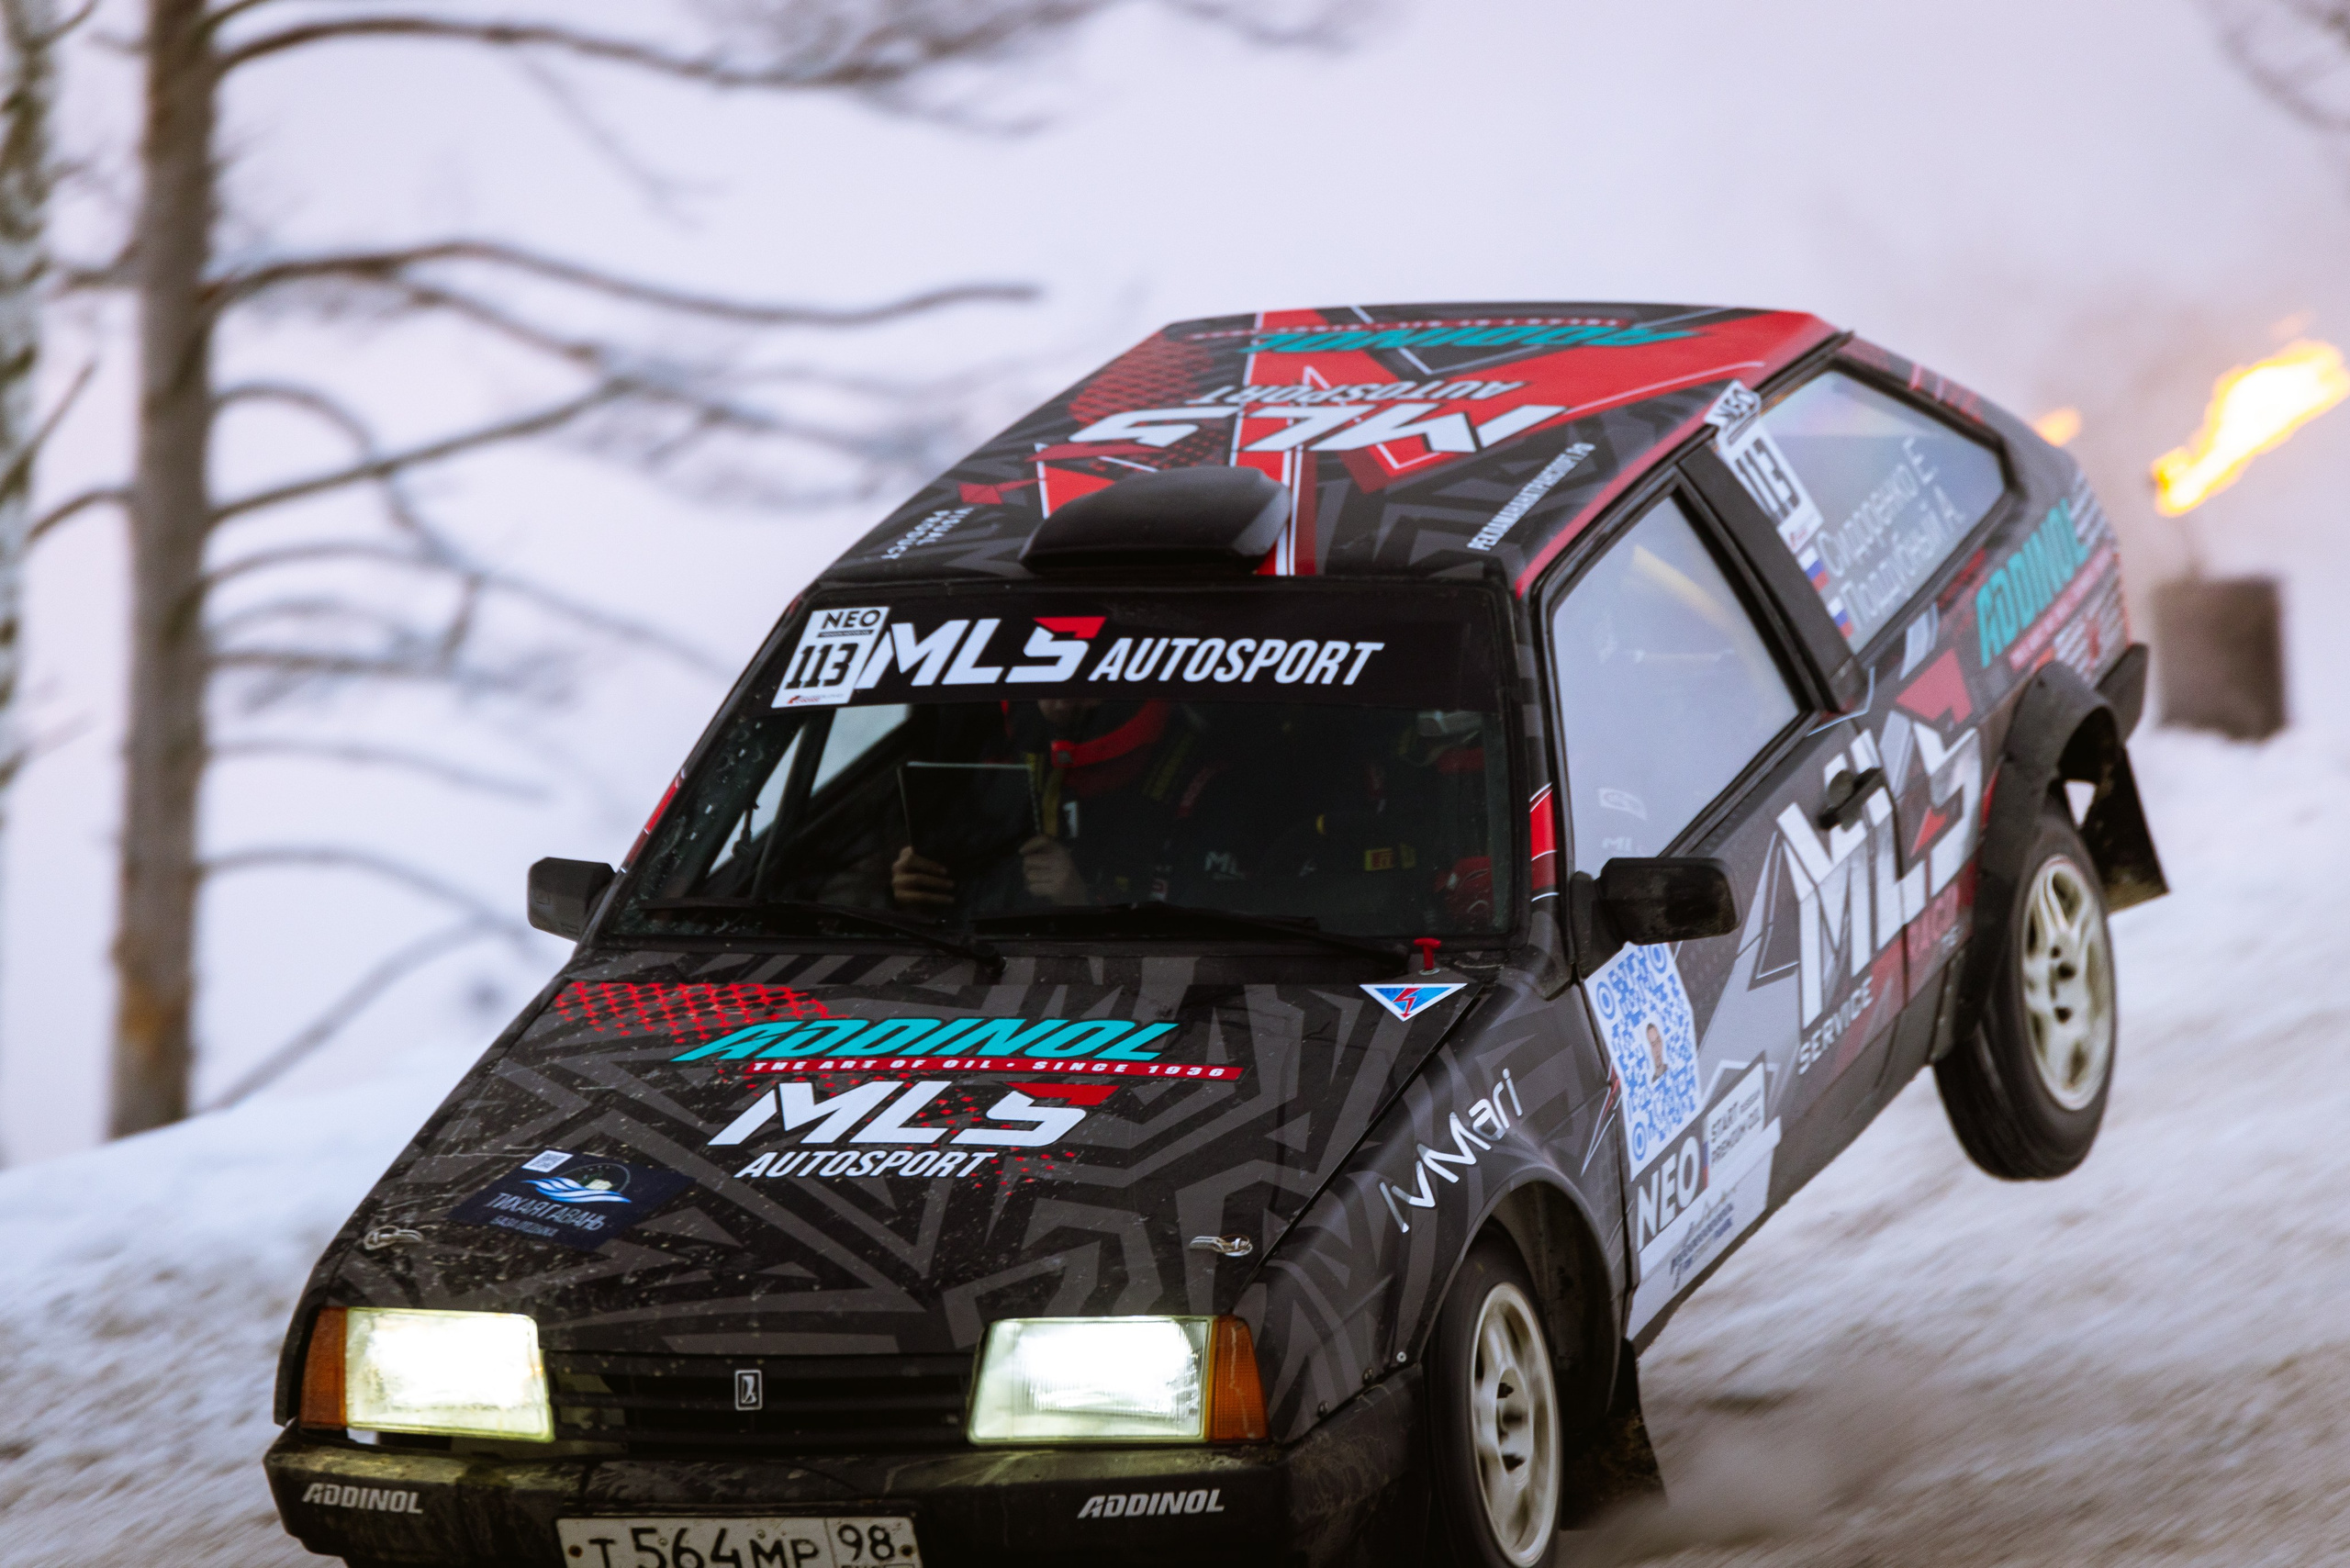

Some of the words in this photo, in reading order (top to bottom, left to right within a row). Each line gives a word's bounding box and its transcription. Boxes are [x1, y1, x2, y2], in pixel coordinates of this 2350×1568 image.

[1185, 380, 1532, 406] AUTOSPORT
[1025, 404, 1568, 461] MLS
[821, 610, 881, 631] NEO
[784, 642, 859, 689] 113
[856, 616, 1106, 689] MLS
[1087, 637, 1384, 685] AUTOSPORT
[668, 1017, 1181, 1062] ADDINOL
[1797, 975, 1874, 1076] SERVICE
[753, 1060, 807, 1071] THE
[817, 1059, 878, 1070] ART
[889, 1058, 928, 1070] OF
[942, 1058, 992, 1070] OIL
[1032, 1061, 1130, 1074] SINCE
[1147, 1065, 1226, 1078] 1936
[706, 1080, 1121, 1148] MLS
[733, 1149, 999, 1179] AUTOSPORT
[1637, 1136, 1699, 1254] NEO
[301, 1482, 423, 1514] ADDINOL
[1077, 1488, 1225, 1519] ADDINOL
[837, 1524, 895, 1562] 98
